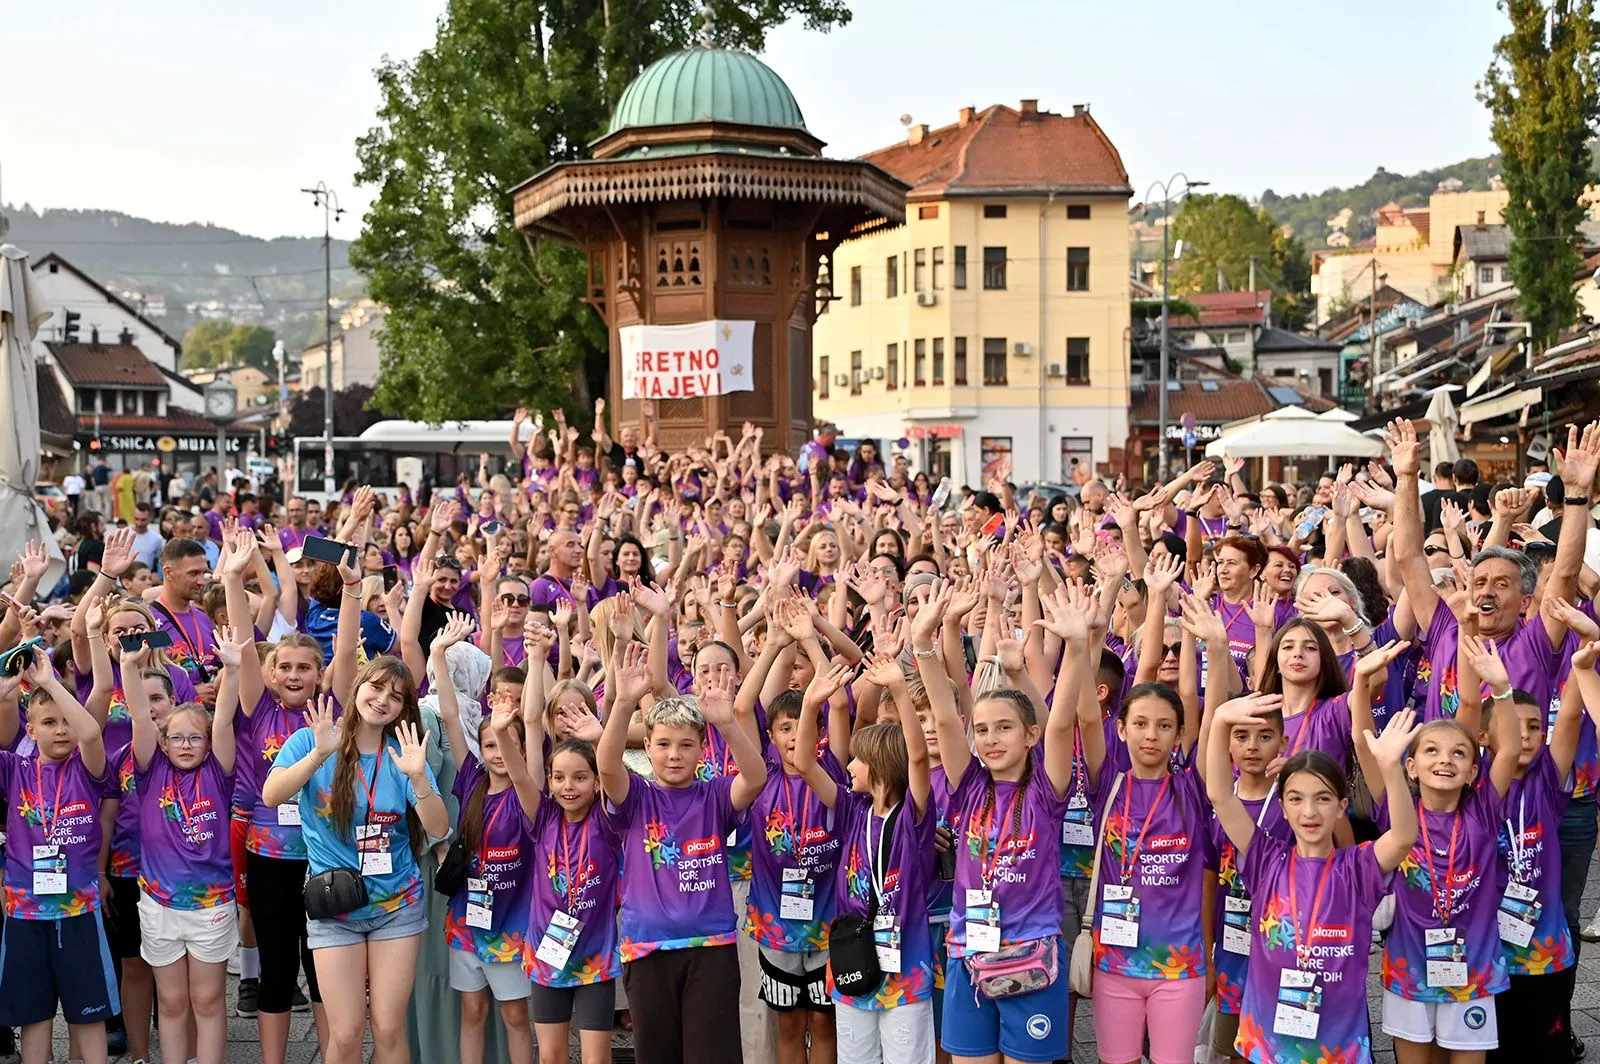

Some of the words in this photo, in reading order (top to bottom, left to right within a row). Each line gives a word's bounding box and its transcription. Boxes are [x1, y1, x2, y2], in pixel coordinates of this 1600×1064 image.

[57, 815, 93, 827] PORTSKE
[53, 827, 72, 836] GRE
[799, 839, 840, 856] PORTSKE
[1151, 837, 1187, 849] plazma
[487, 849, 519, 859] plazma
[484, 858, 523, 872] PORTSKE
[1141, 865, 1167, 875] IGRE
[481, 873, 500, 882] GRE
[679, 879, 716, 892] MLADIH
[1312, 926, 1347, 938] plazma
[836, 970, 863, 986] adidas
